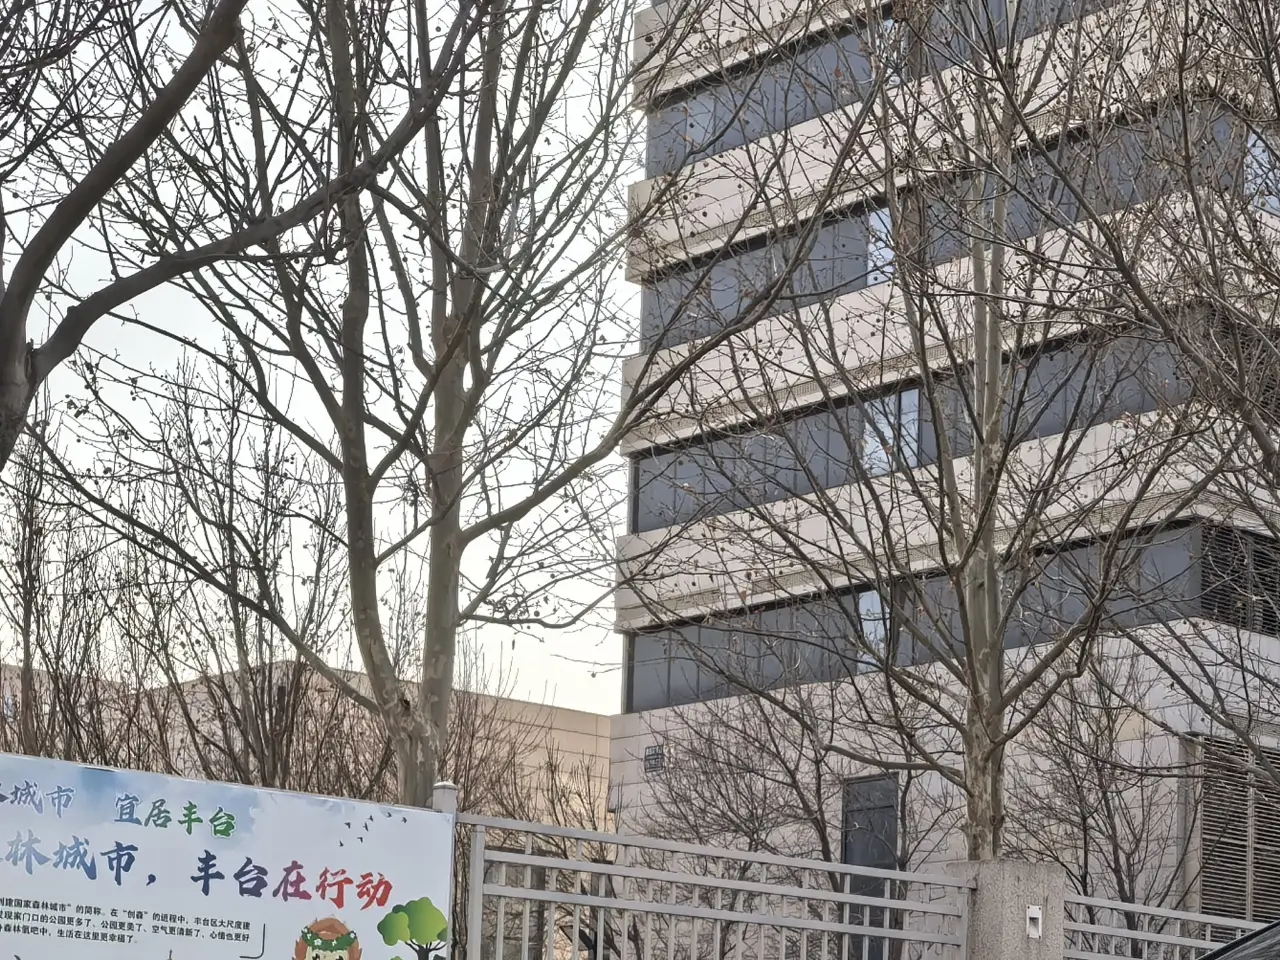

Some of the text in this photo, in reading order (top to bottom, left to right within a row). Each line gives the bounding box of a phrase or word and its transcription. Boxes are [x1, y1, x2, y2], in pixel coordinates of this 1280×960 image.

[113, 793, 236, 838] 宜居丰台
[0, 829, 393, 911] 林城市，丰台在行动
